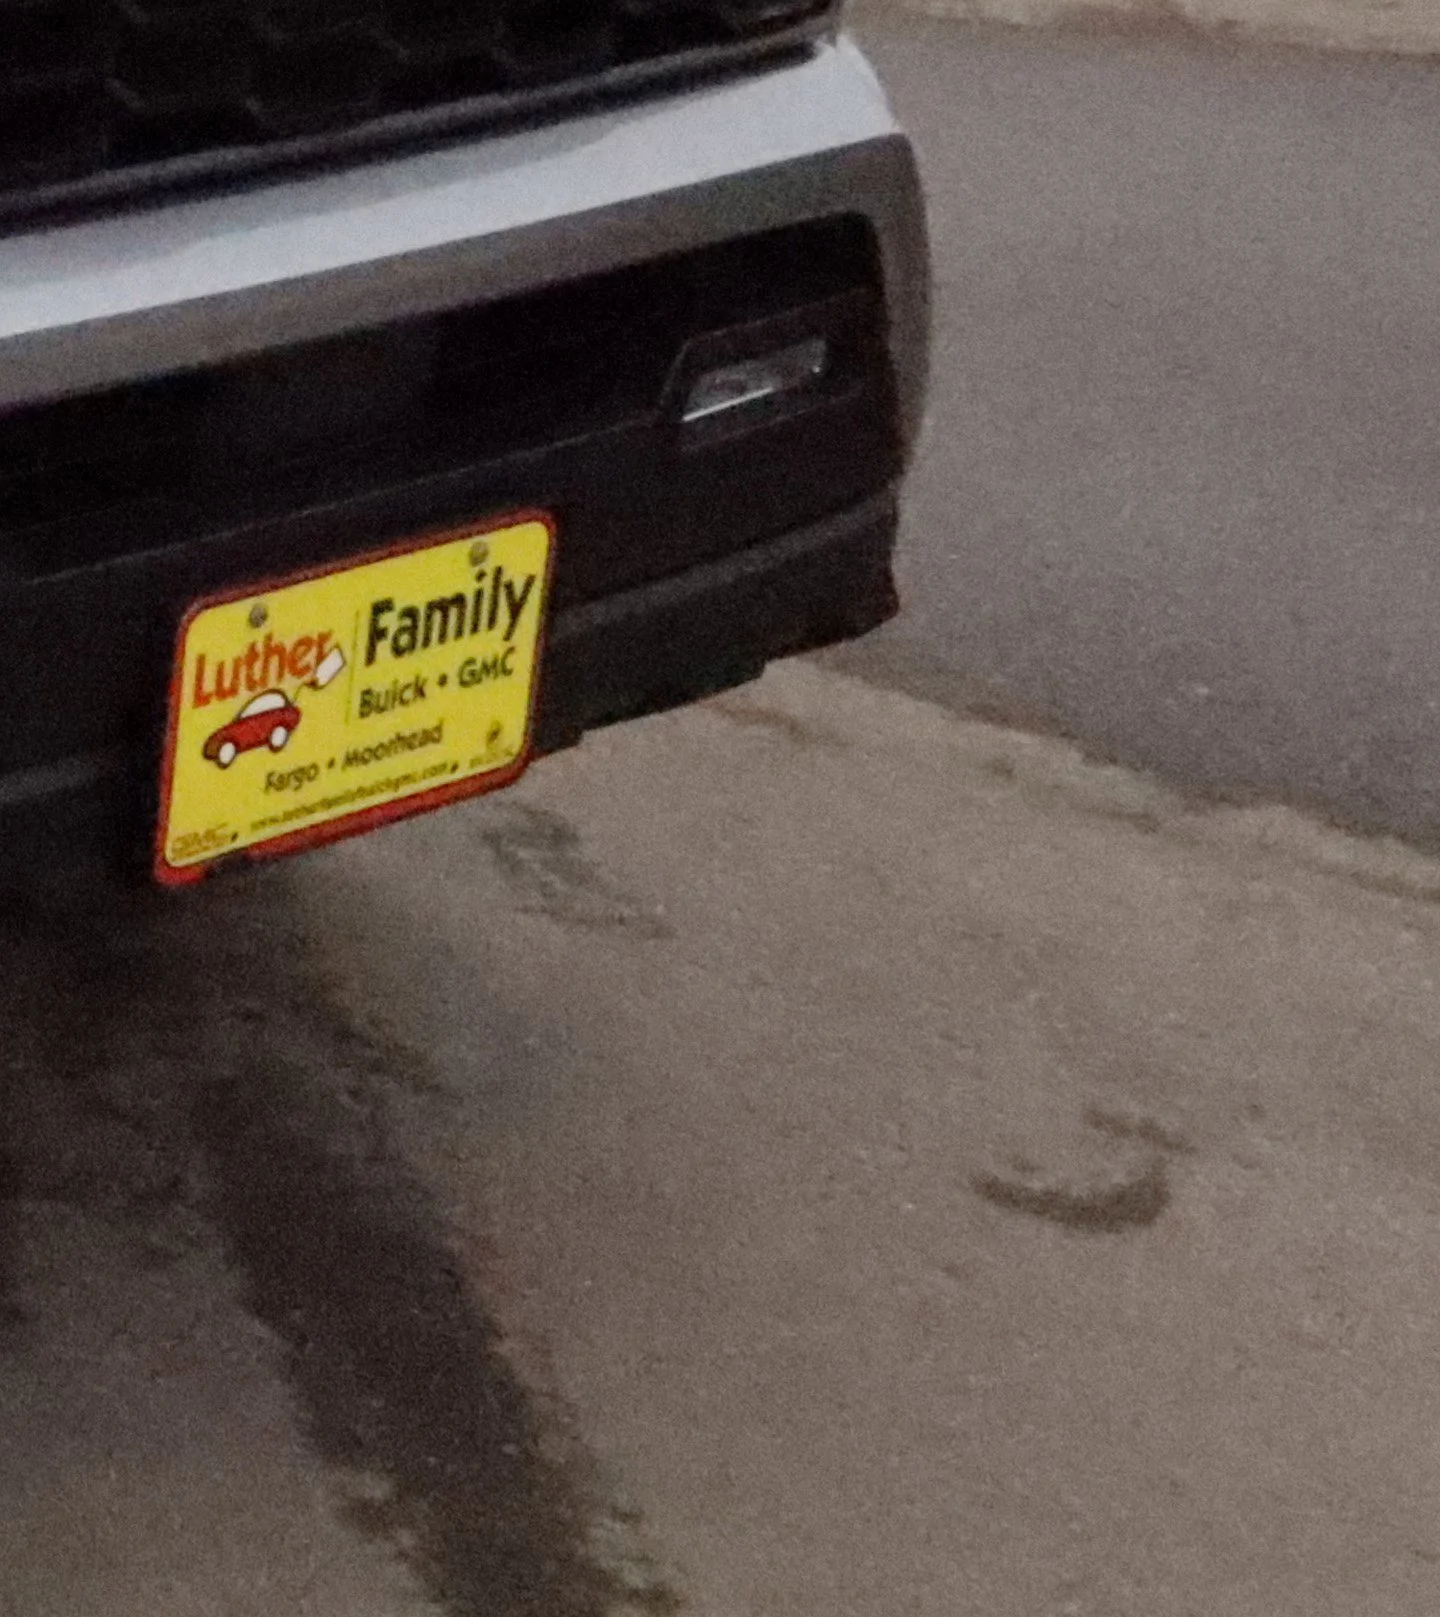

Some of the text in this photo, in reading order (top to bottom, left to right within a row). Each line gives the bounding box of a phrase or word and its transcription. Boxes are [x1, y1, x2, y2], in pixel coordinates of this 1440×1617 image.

[364, 566, 536, 667] Family
[192, 629, 334, 708] Luther
[359, 646, 516, 719] Buick GMC
[340, 719, 444, 771] Moorhead
